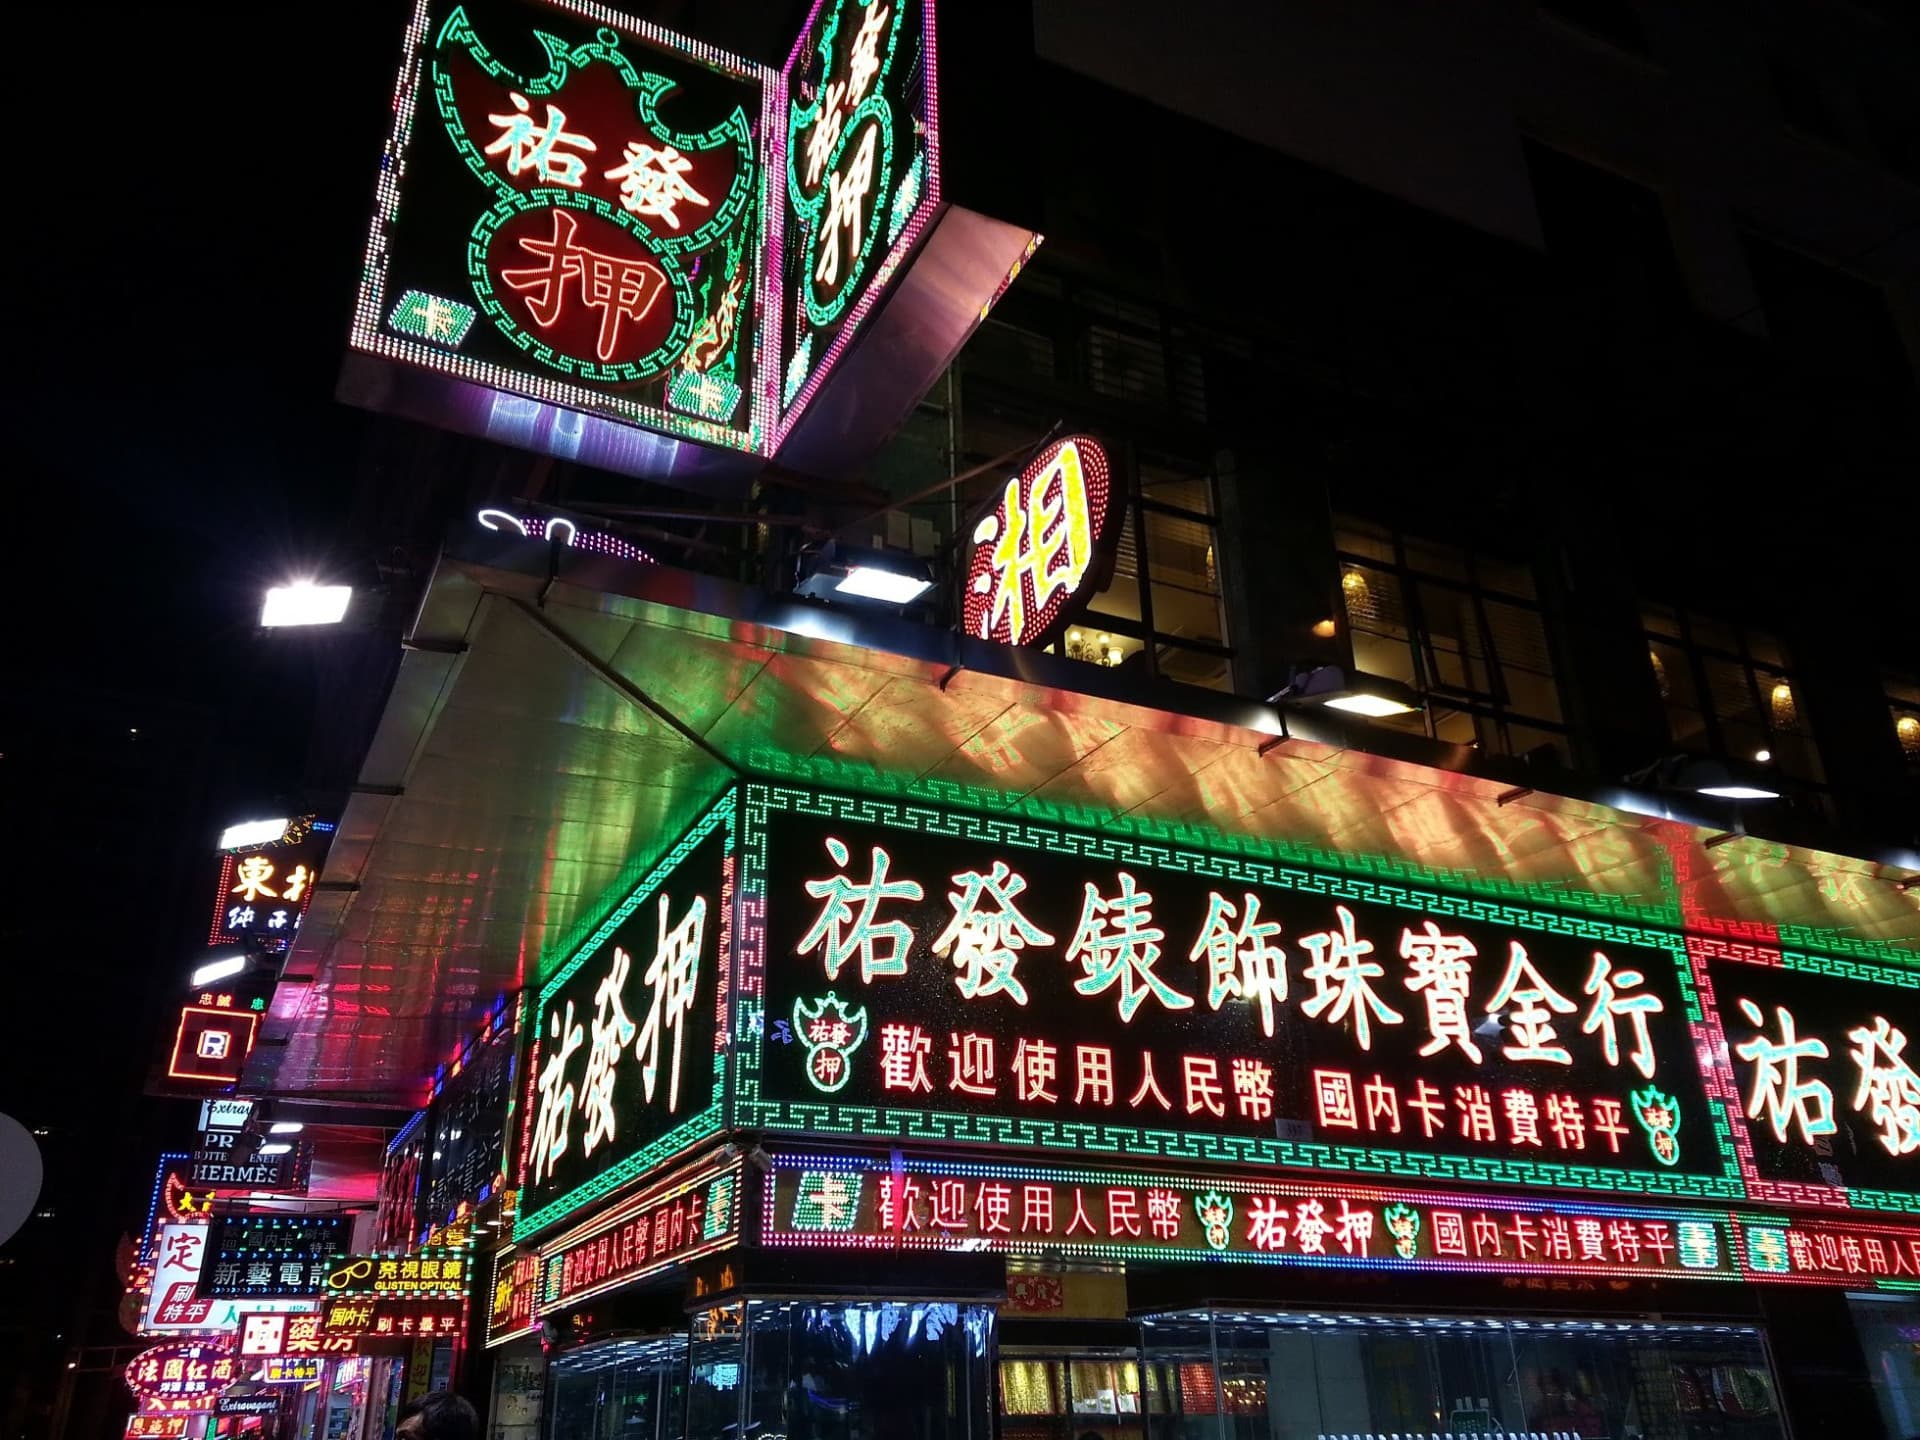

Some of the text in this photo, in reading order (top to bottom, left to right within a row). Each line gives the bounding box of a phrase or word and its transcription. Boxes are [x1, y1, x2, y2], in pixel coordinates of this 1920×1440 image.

[485, 92, 710, 229] 祐發
[815, 123, 877, 286] 押
[501, 208, 666, 361] 押
[798, 836, 1664, 1080] 祐發錶飾珠寶金行
[530, 892, 707, 1186] 祐發押
[808, 1019, 852, 1046] 祐發
[813, 1048, 842, 1086] 押
[880, 1023, 1275, 1122] 歡迎使用人民幣
[1248, 1197, 1374, 1259] 祐發押
[163, 1304, 208, 1322] 特平
[374, 1281, 463, 1291] GLISTEN OPTICAL
